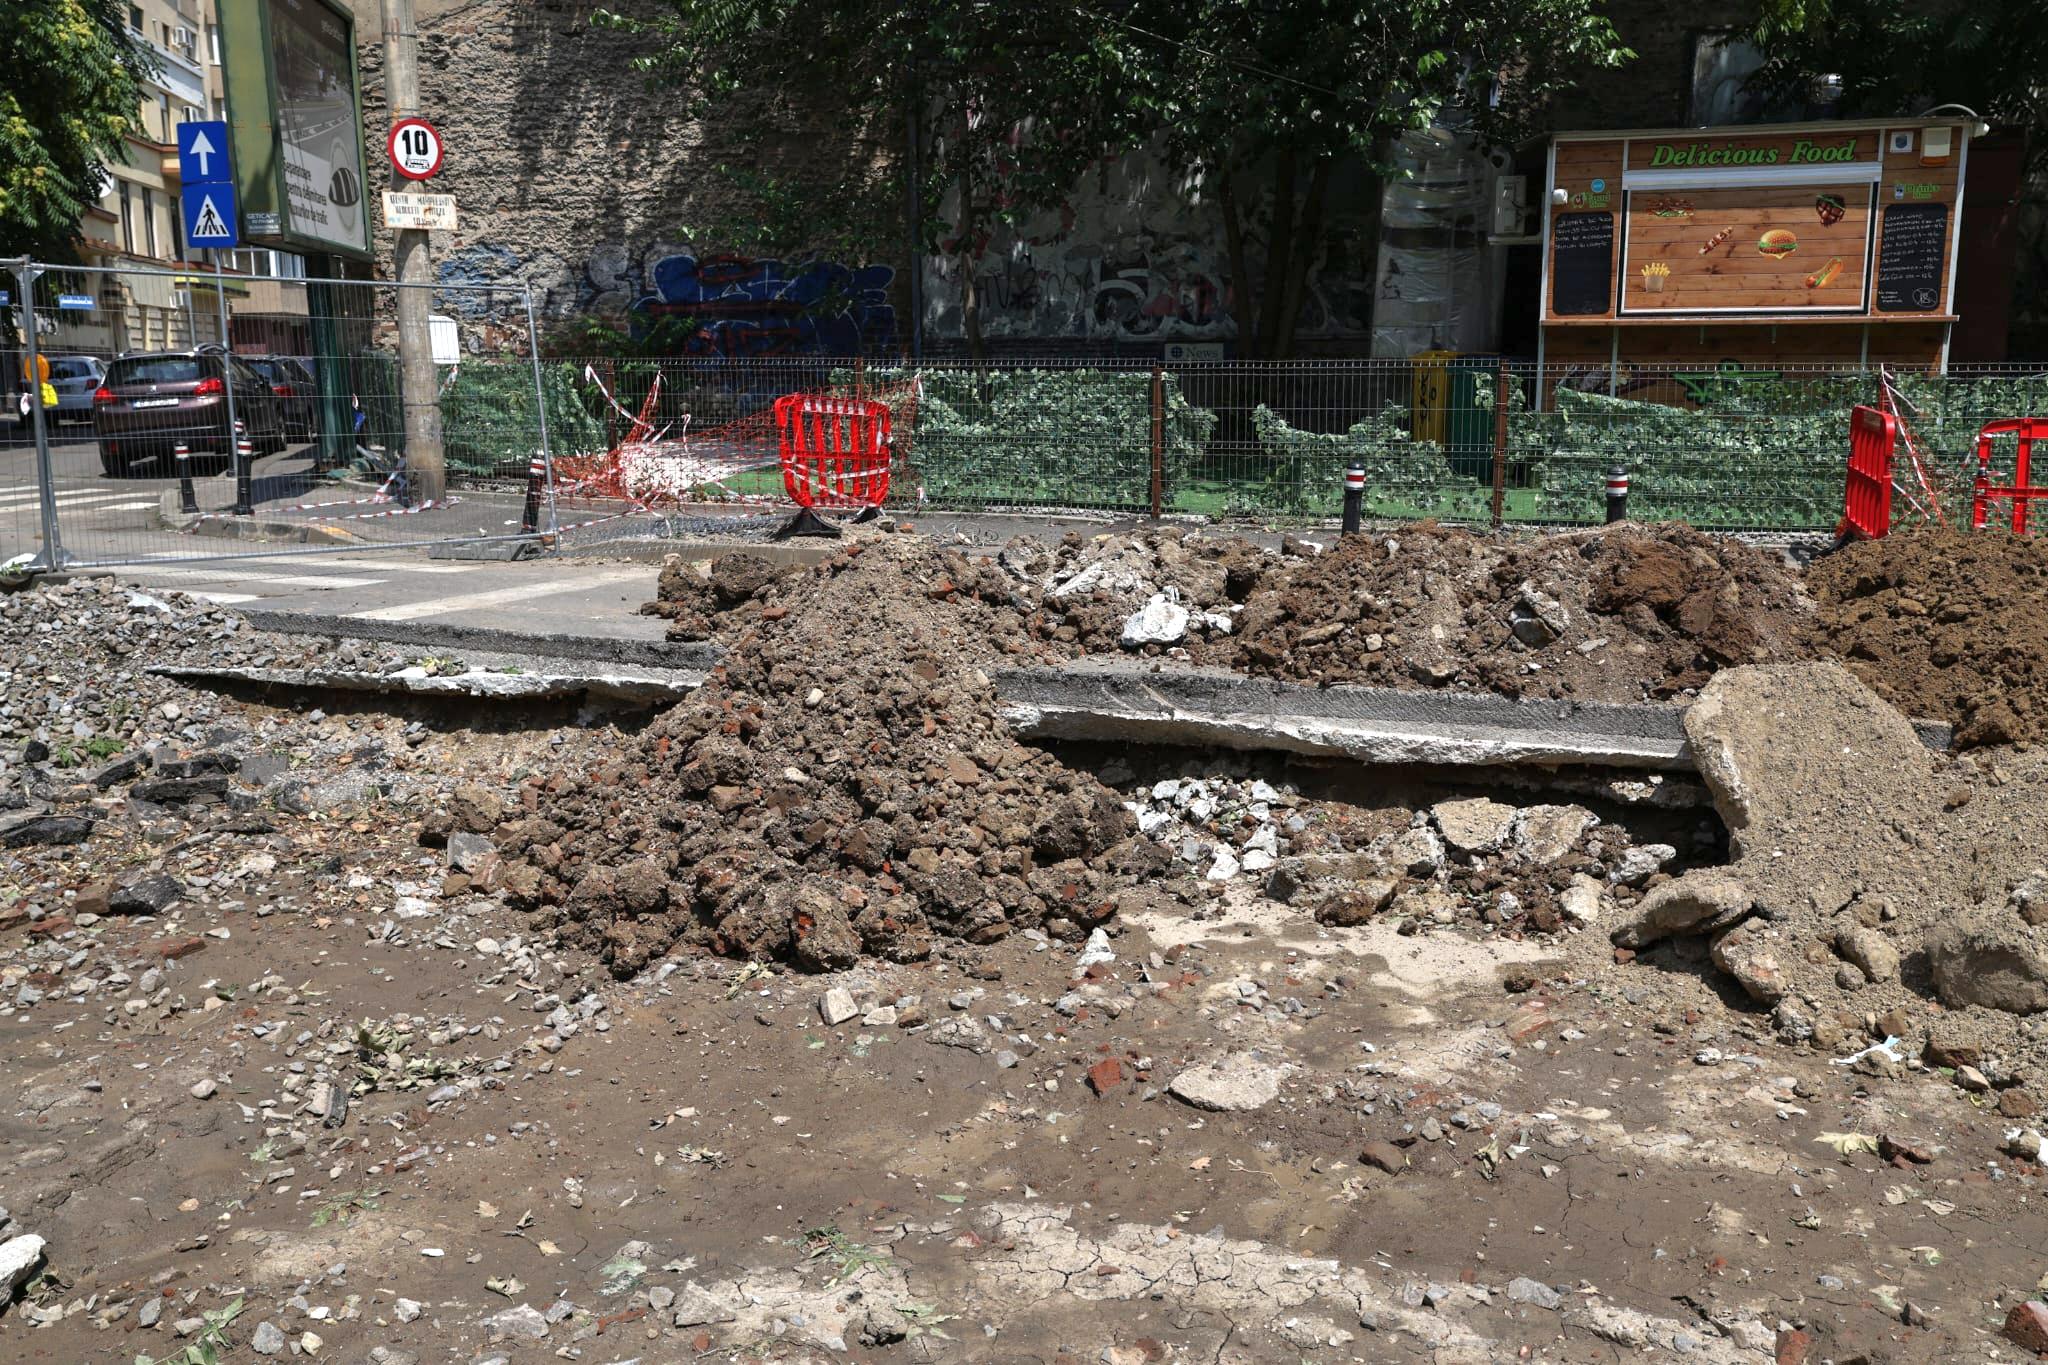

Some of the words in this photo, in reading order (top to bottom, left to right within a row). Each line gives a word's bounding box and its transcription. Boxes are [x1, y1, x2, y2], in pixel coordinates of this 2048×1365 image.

[402, 130, 428, 156] 10
[1651, 143, 1779, 166] Delicious
[1788, 139, 1857, 163] Food
[1186, 346, 1219, 358] News
